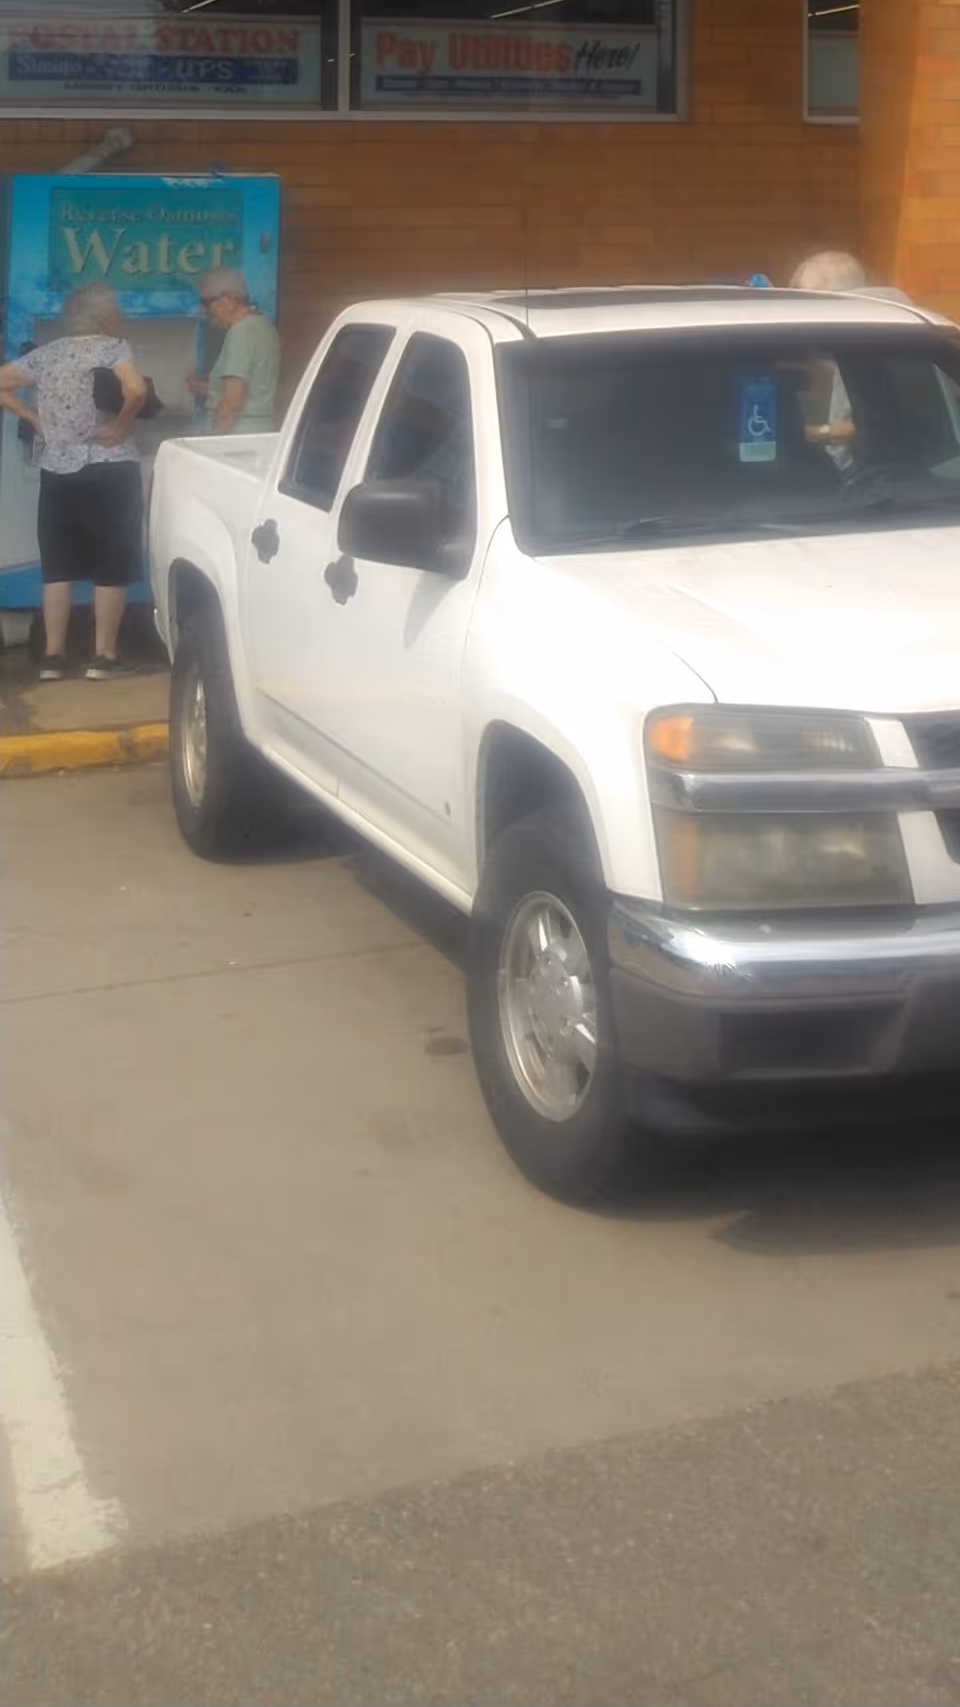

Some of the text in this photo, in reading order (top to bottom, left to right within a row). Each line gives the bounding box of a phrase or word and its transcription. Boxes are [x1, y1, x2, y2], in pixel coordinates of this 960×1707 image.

[153, 24, 299, 55] STATION
[375, 29, 641, 74] Pay Utilities Here!
[176, 59, 235, 81] UPS
[62, 225, 235, 278] Water
